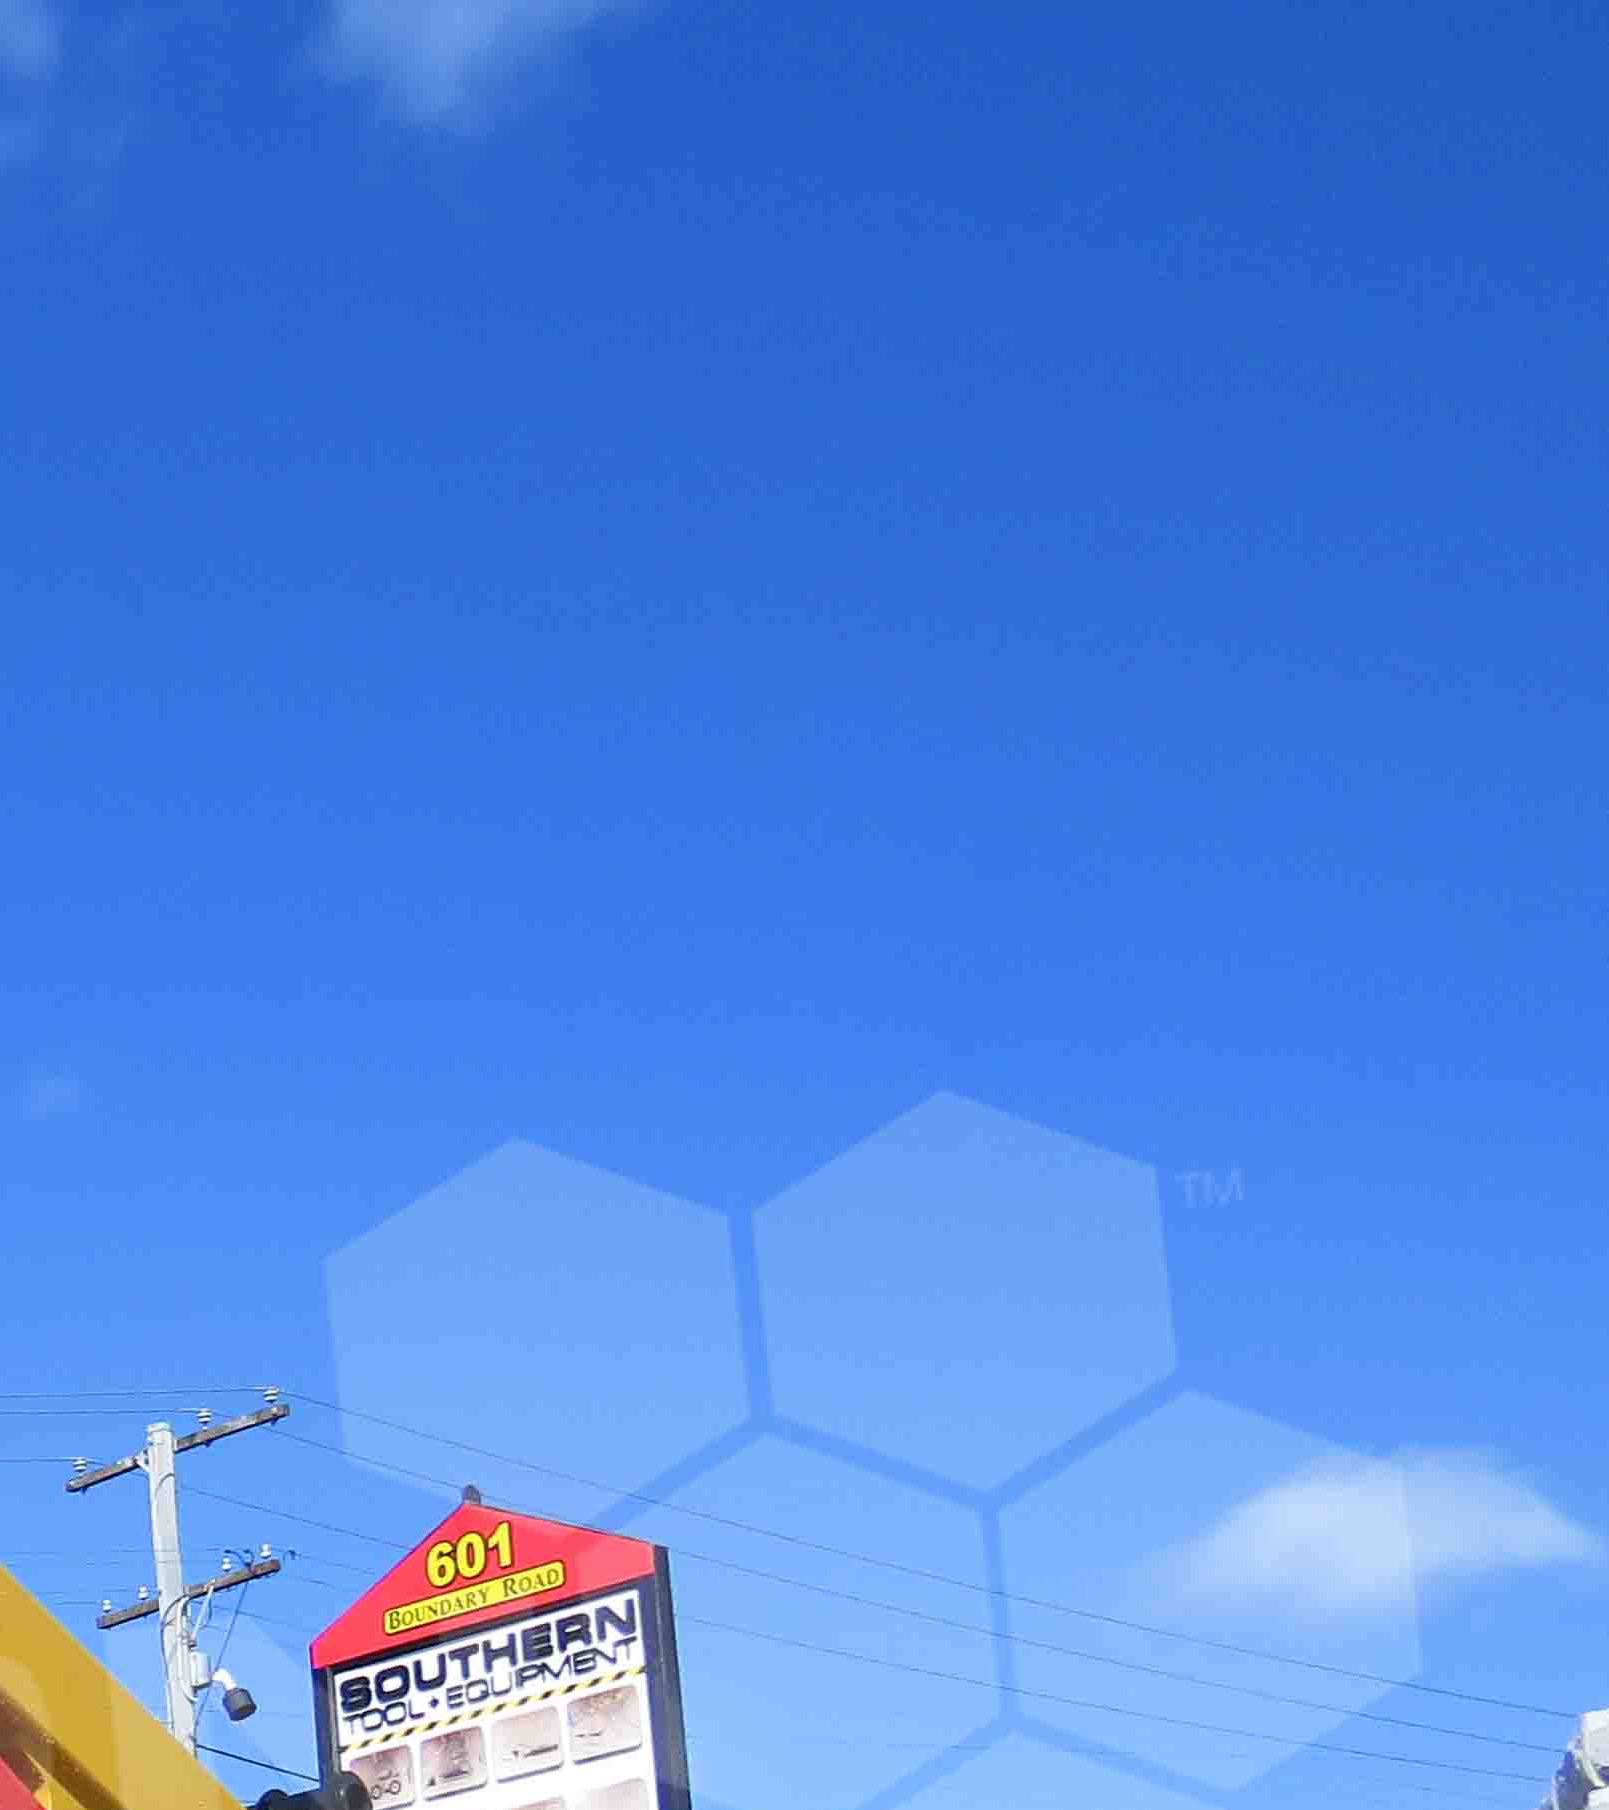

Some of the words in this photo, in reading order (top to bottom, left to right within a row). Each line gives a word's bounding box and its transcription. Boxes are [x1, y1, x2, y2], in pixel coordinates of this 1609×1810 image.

[425, 1521, 516, 1588] 601
[338, 1599, 639, 1716] SOUTHERN
[343, 1696, 425, 1737] TOOL
[447, 1637, 637, 1713] EQUIPMENT
